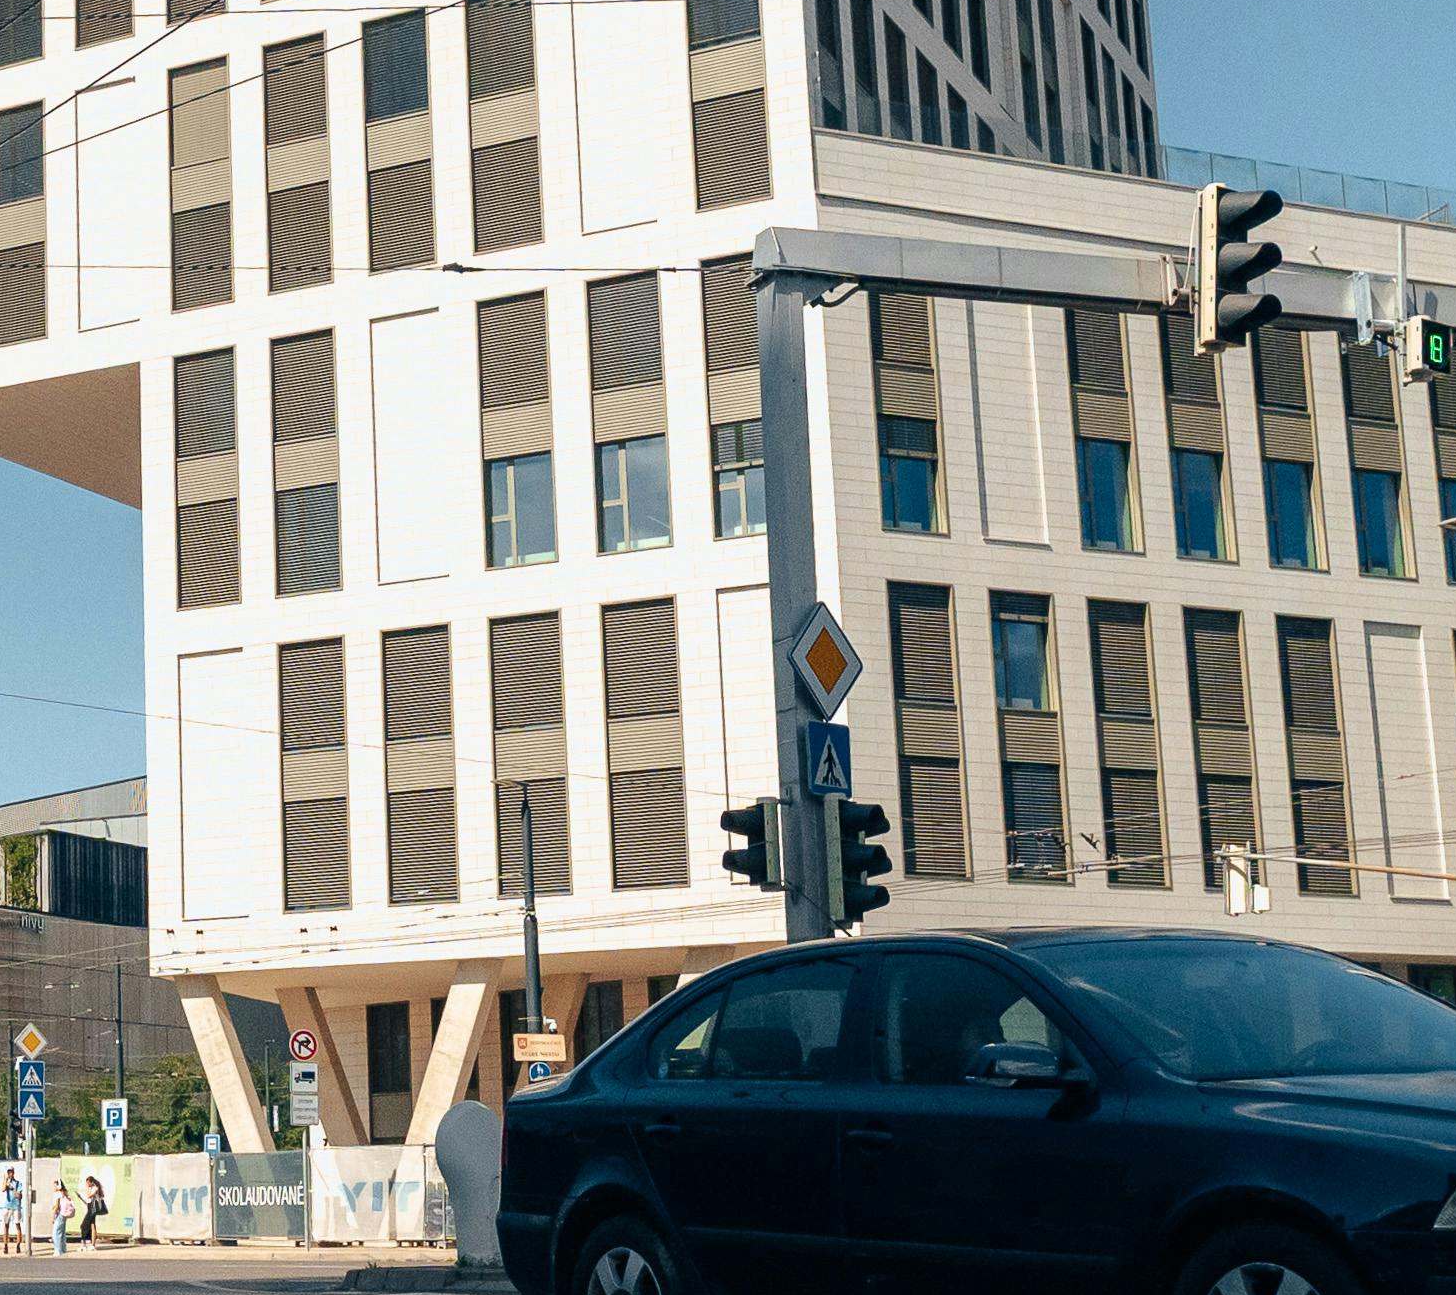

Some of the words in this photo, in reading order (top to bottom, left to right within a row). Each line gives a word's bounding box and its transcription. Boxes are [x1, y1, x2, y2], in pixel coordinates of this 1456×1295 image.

[109, 1109, 120, 1126] P
[159, 1185, 209, 1216] YIT
[218, 1181, 305, 1207] SKOLAUDOVANÉ
[341, 1180, 423, 1214] YIT
